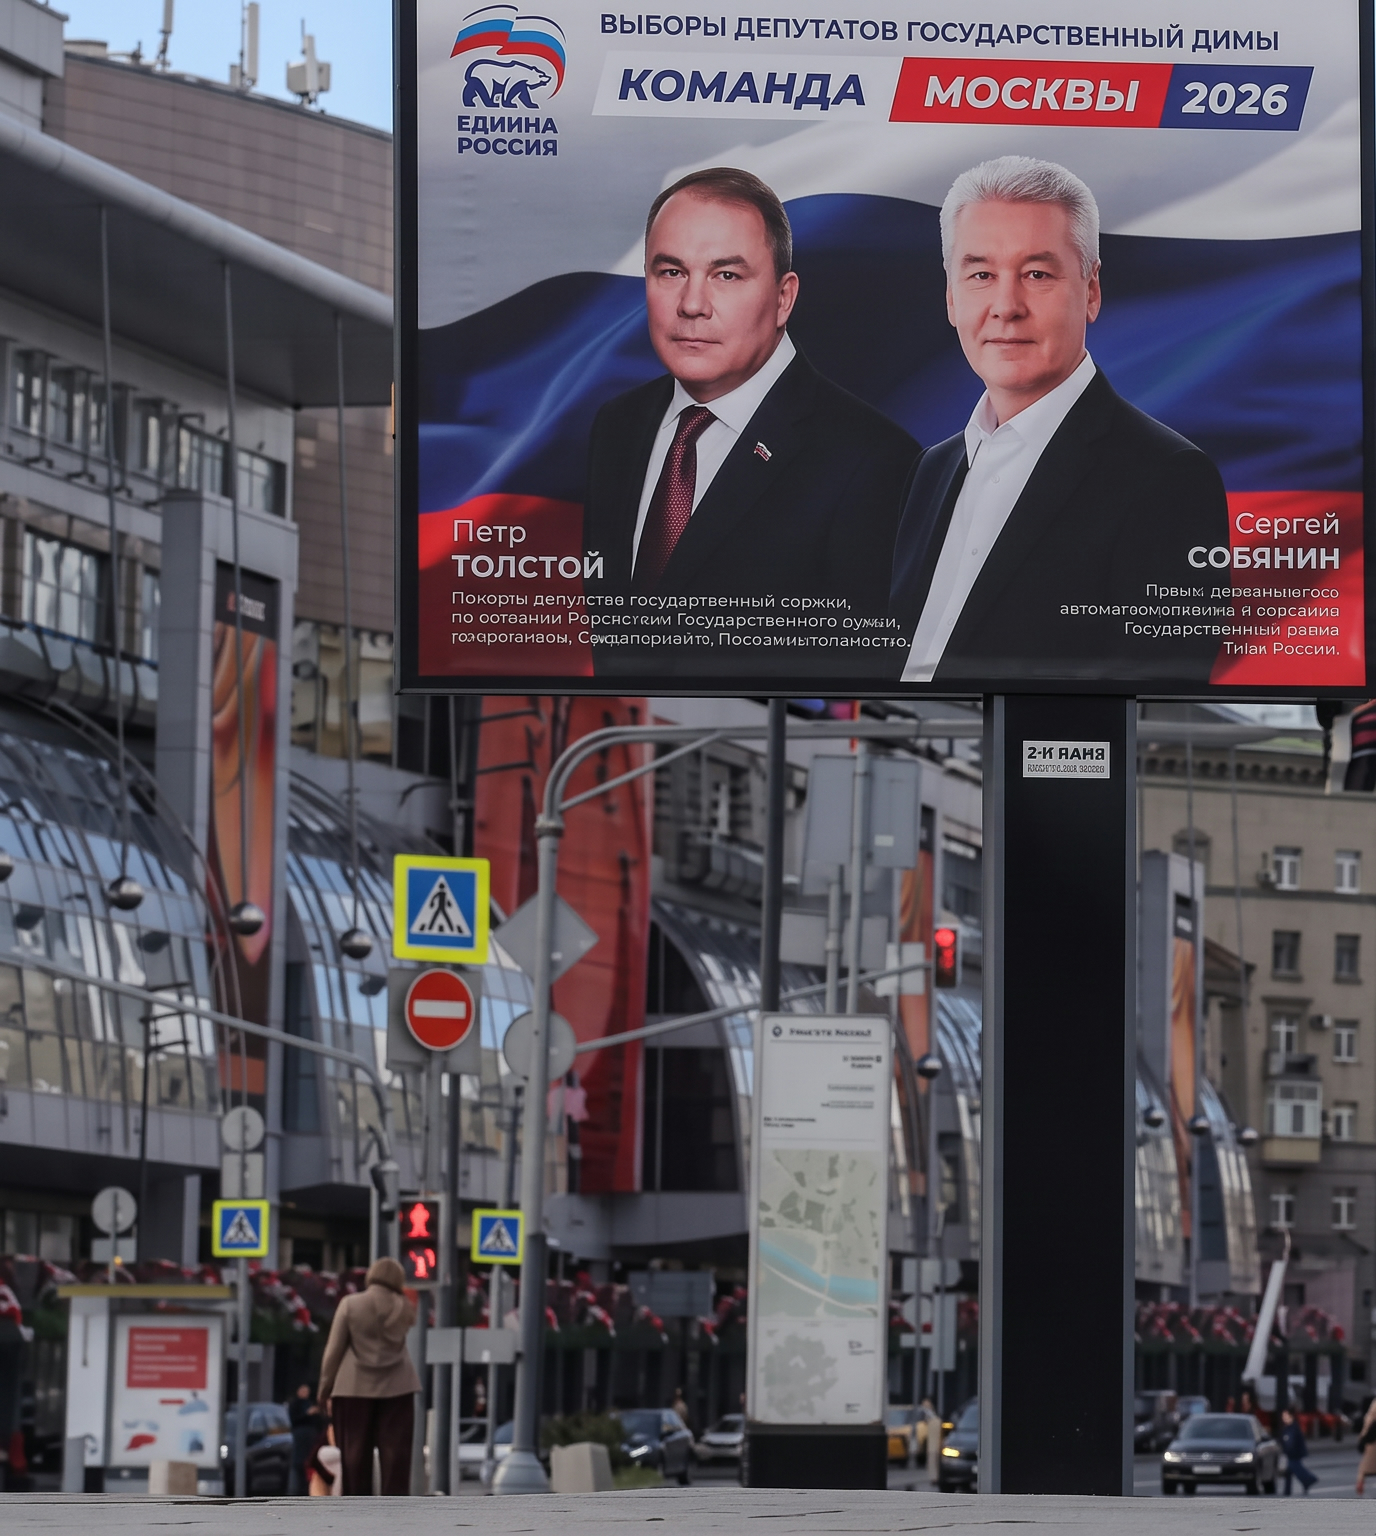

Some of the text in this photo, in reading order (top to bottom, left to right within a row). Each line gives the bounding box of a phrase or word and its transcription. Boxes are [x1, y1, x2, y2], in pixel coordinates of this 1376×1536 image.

[601, 13, 1279, 53] ВЫБОРЫ ДЕПУТАТОВ ГОСУДАРСТВЕННЫЙ ДИМЫ
[618, 69, 1290, 116] КОМАНДА МОСКВЫ 2026
[457, 115, 559, 135] ЕДИИНА
[457, 137, 558, 156] РОССИЯ
[453, 519, 527, 548] Петр
[1235, 512, 1339, 539] Сергей
[451, 551, 604, 579] ТОЛСТОЙ
[1187, 546, 1340, 570] СОБЯНИН
[452, 591, 528, 608] Покорты
[630, 594, 775, 610] государтвенный
[781, 597, 851, 611] соржки,
[452, 613, 474, 624] по
[677, 612, 837, 630] Государственного
[1273, 642, 1340, 655] России.
